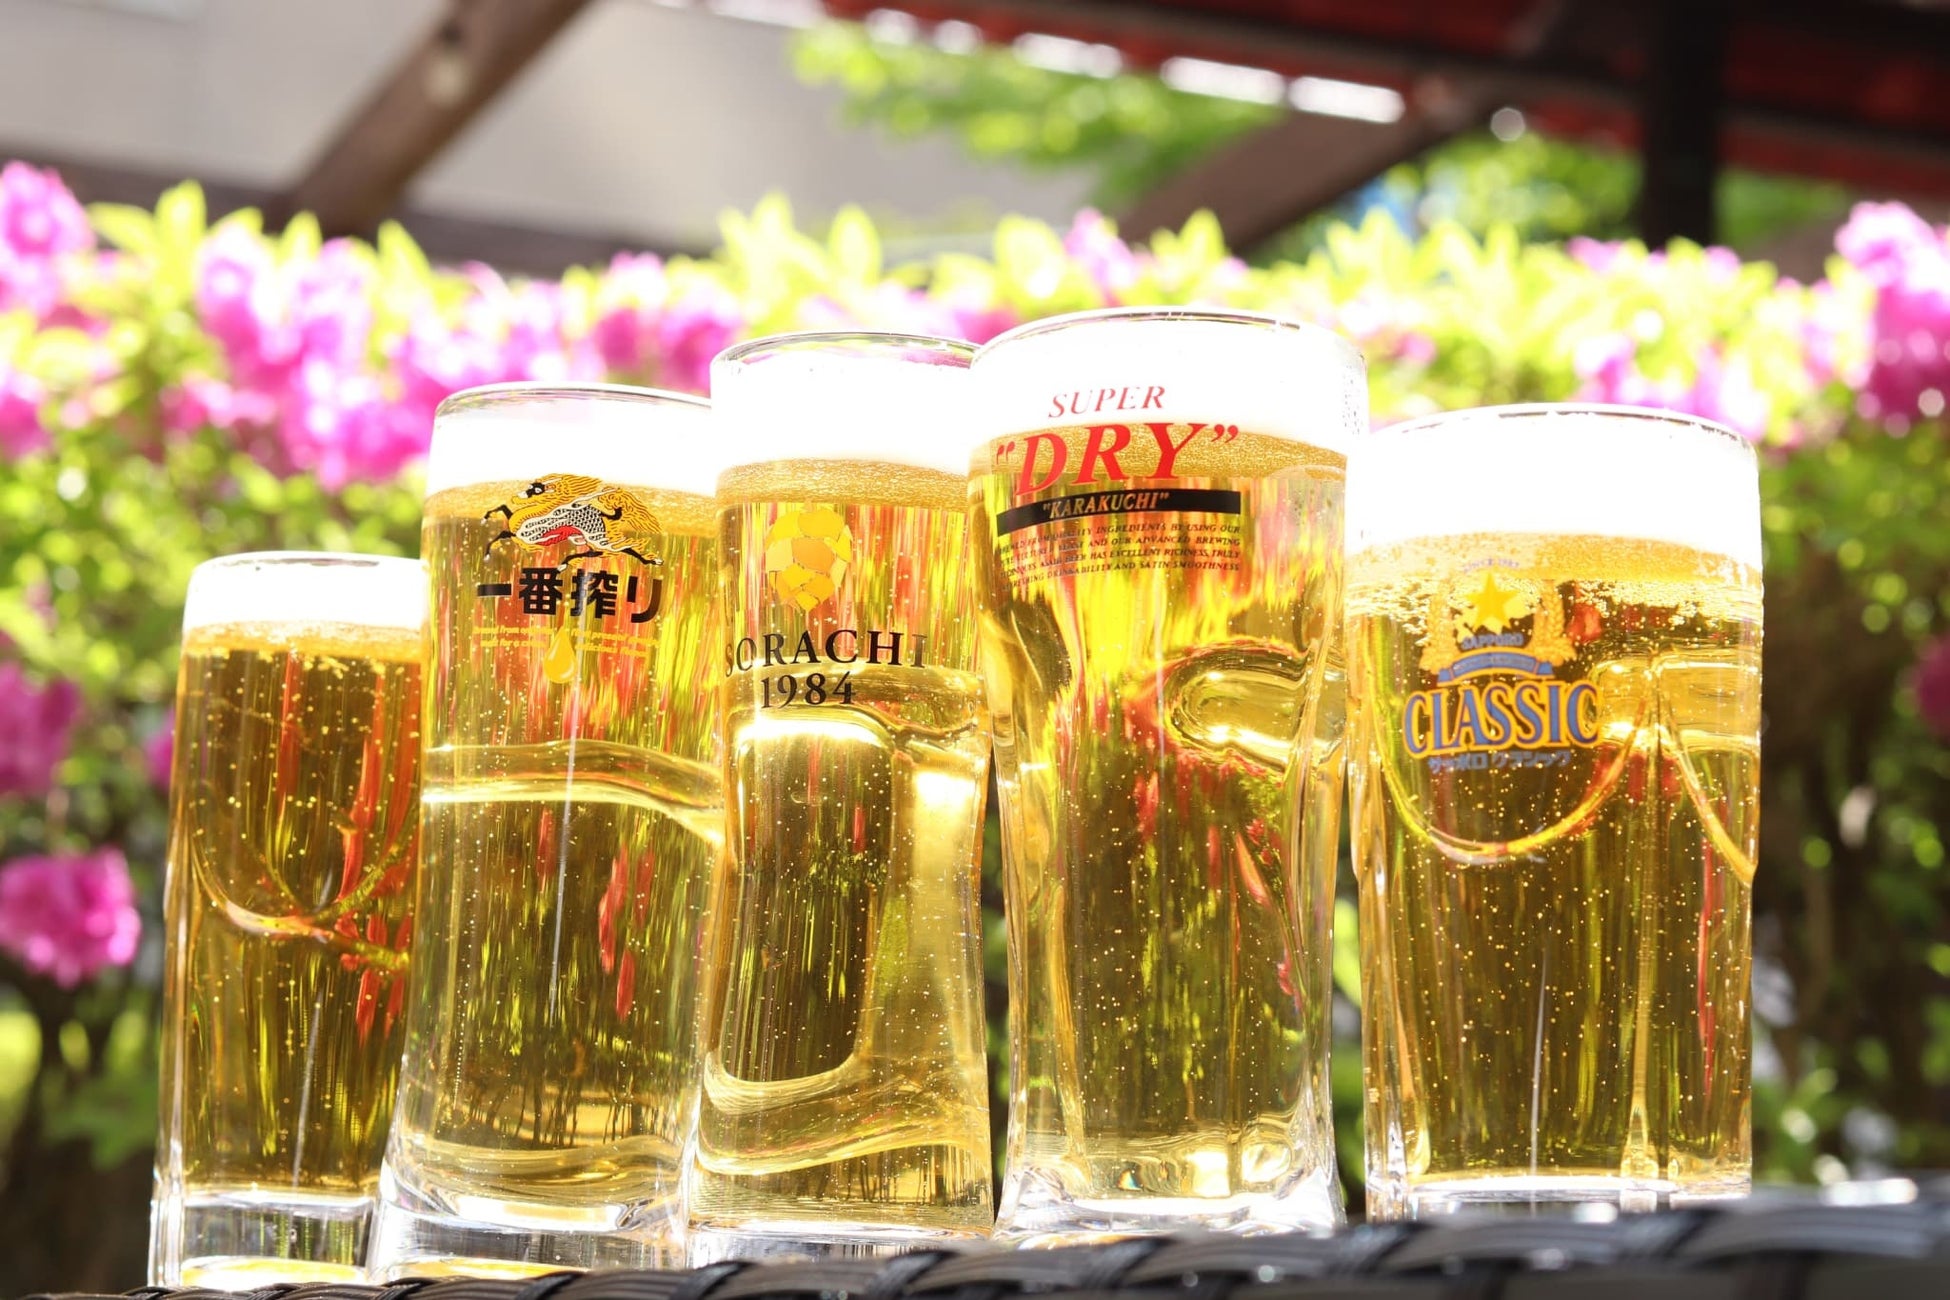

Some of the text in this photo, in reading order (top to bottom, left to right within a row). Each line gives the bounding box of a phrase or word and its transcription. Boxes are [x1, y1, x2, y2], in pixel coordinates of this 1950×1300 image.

[1048, 385, 1166, 418] SUPER
[1089, 538, 1108, 547] AND
[1195, 536, 1241, 547] BREWING
[1220, 524, 1241, 534] OUR
[1090, 551, 1108, 560] HAS
[1114, 561, 1137, 571] AND
[477, 567, 663, 624] 一番搾り
[724, 629, 928, 678] SORACHI
[1461, 632, 1524, 650] SAPPORO
[761, 670, 857, 709] 1984
[1402, 679, 1600, 759] CLASSIC
